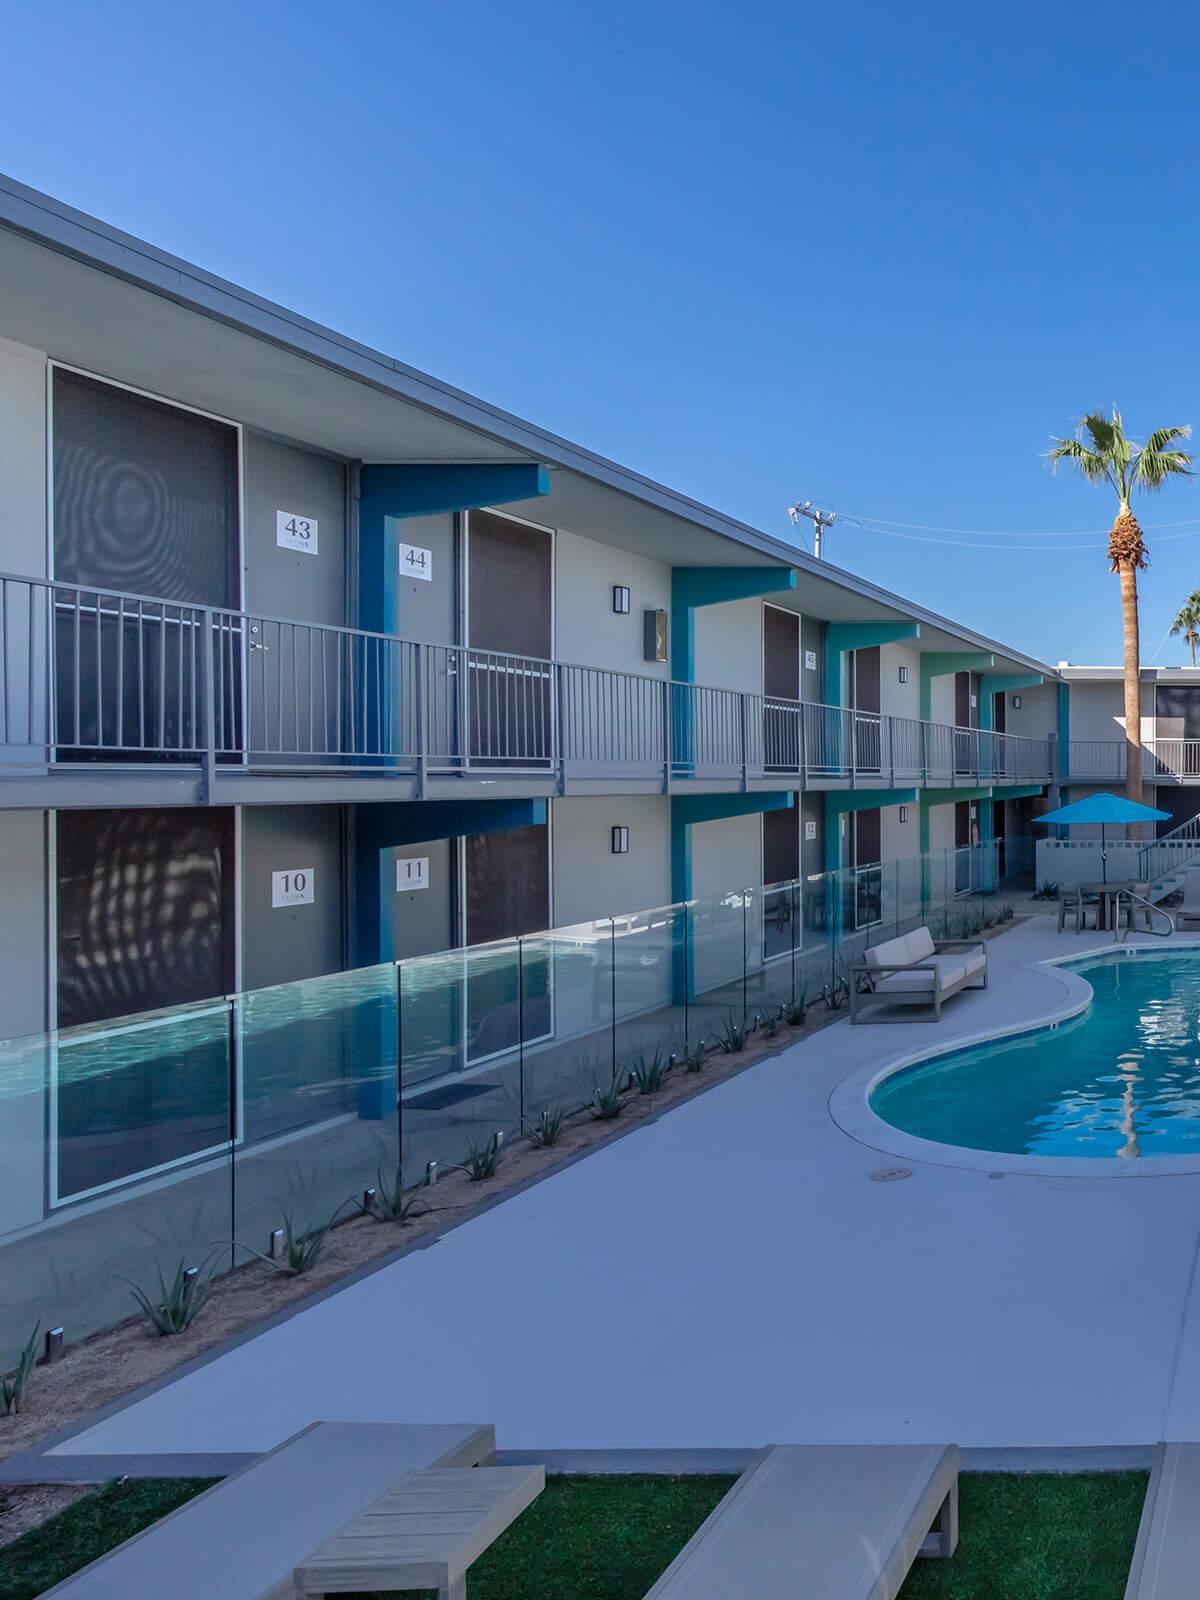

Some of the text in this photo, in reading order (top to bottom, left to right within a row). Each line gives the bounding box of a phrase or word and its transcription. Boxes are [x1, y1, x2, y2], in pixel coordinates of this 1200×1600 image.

[285, 518, 310, 540] 43
[405, 550, 426, 568] 44
[405, 862, 421, 879] 11
[281, 873, 306, 893] 10
